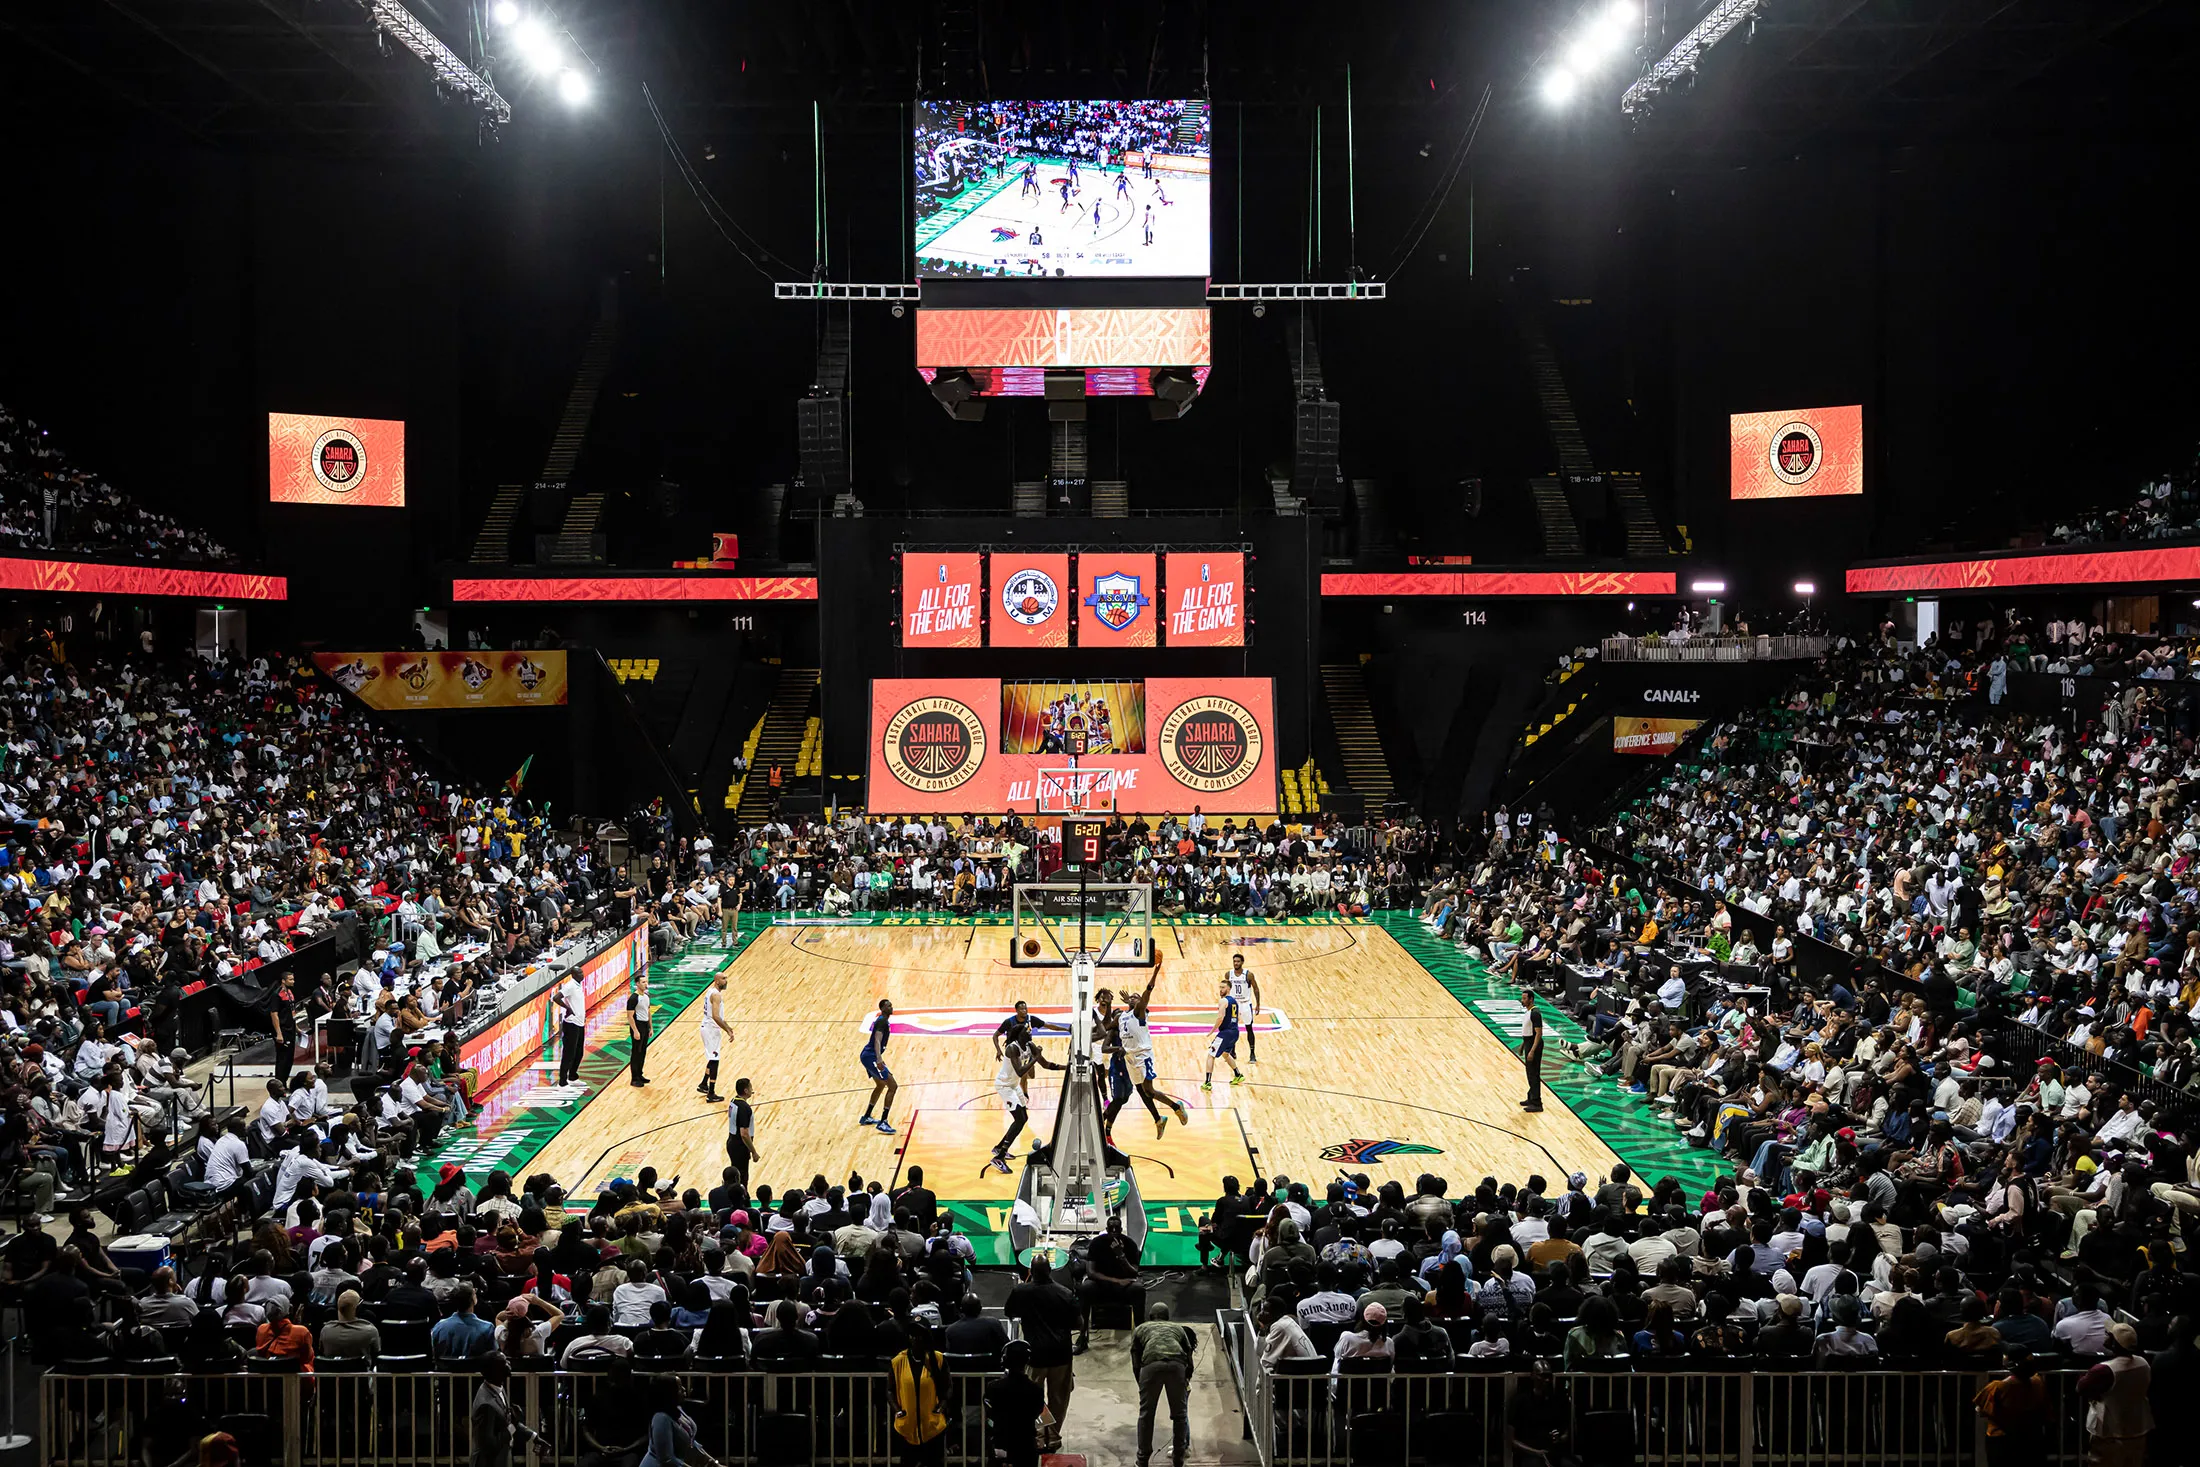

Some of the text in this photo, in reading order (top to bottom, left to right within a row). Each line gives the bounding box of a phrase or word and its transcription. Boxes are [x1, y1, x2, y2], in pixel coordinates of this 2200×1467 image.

[326, 446, 353, 460] SAHARA
[1782, 439, 1810, 452] SAHARA
[918, 583, 971, 612] ALL FOR
[1018, 584, 1044, 592] 19 23
[1181, 582, 1234, 611] ALL FOR
[60, 616, 72, 632] 110
[732, 616, 753, 630] 111
[910, 606, 976, 636] THE GAME
[1172, 604, 1238, 635] THE GAME
[1463, 610, 1487, 626] 114
[1644, 690, 1700, 702] CANAL+
[2060, 678, 2075, 698] 116
[888, 700, 983, 745] BASKETBALL AFRICA LEAGUE
[1163, 700, 1258, 744] BASKETBALL AFRICA LEAGUE
[1186, 722, 1236, 742] SAHARA
[910, 724, 960, 742] SAHARA
[1652, 732, 1676, 744] SAHARA
[1076, 740, 1084, 752] 9
[892, 760, 978, 788] SAHARA CONFERENCE
[1169, 759, 1255, 788] SAHARA CONFERENCE
[1006, 768, 1140, 802] ALL FOR THE GAME
[1075, 824, 1101, 836] 6:20
[1085, 839, 1098, 861] 9
[1108, 917, 1229, 926] AFRICA
[1245, 917, 1375, 926] LEAGUE
[1235, 984, 1242, 994] 10
[431, 1137, 489, 1163] VISIT
[460, 1129, 534, 1173] RWANDA
